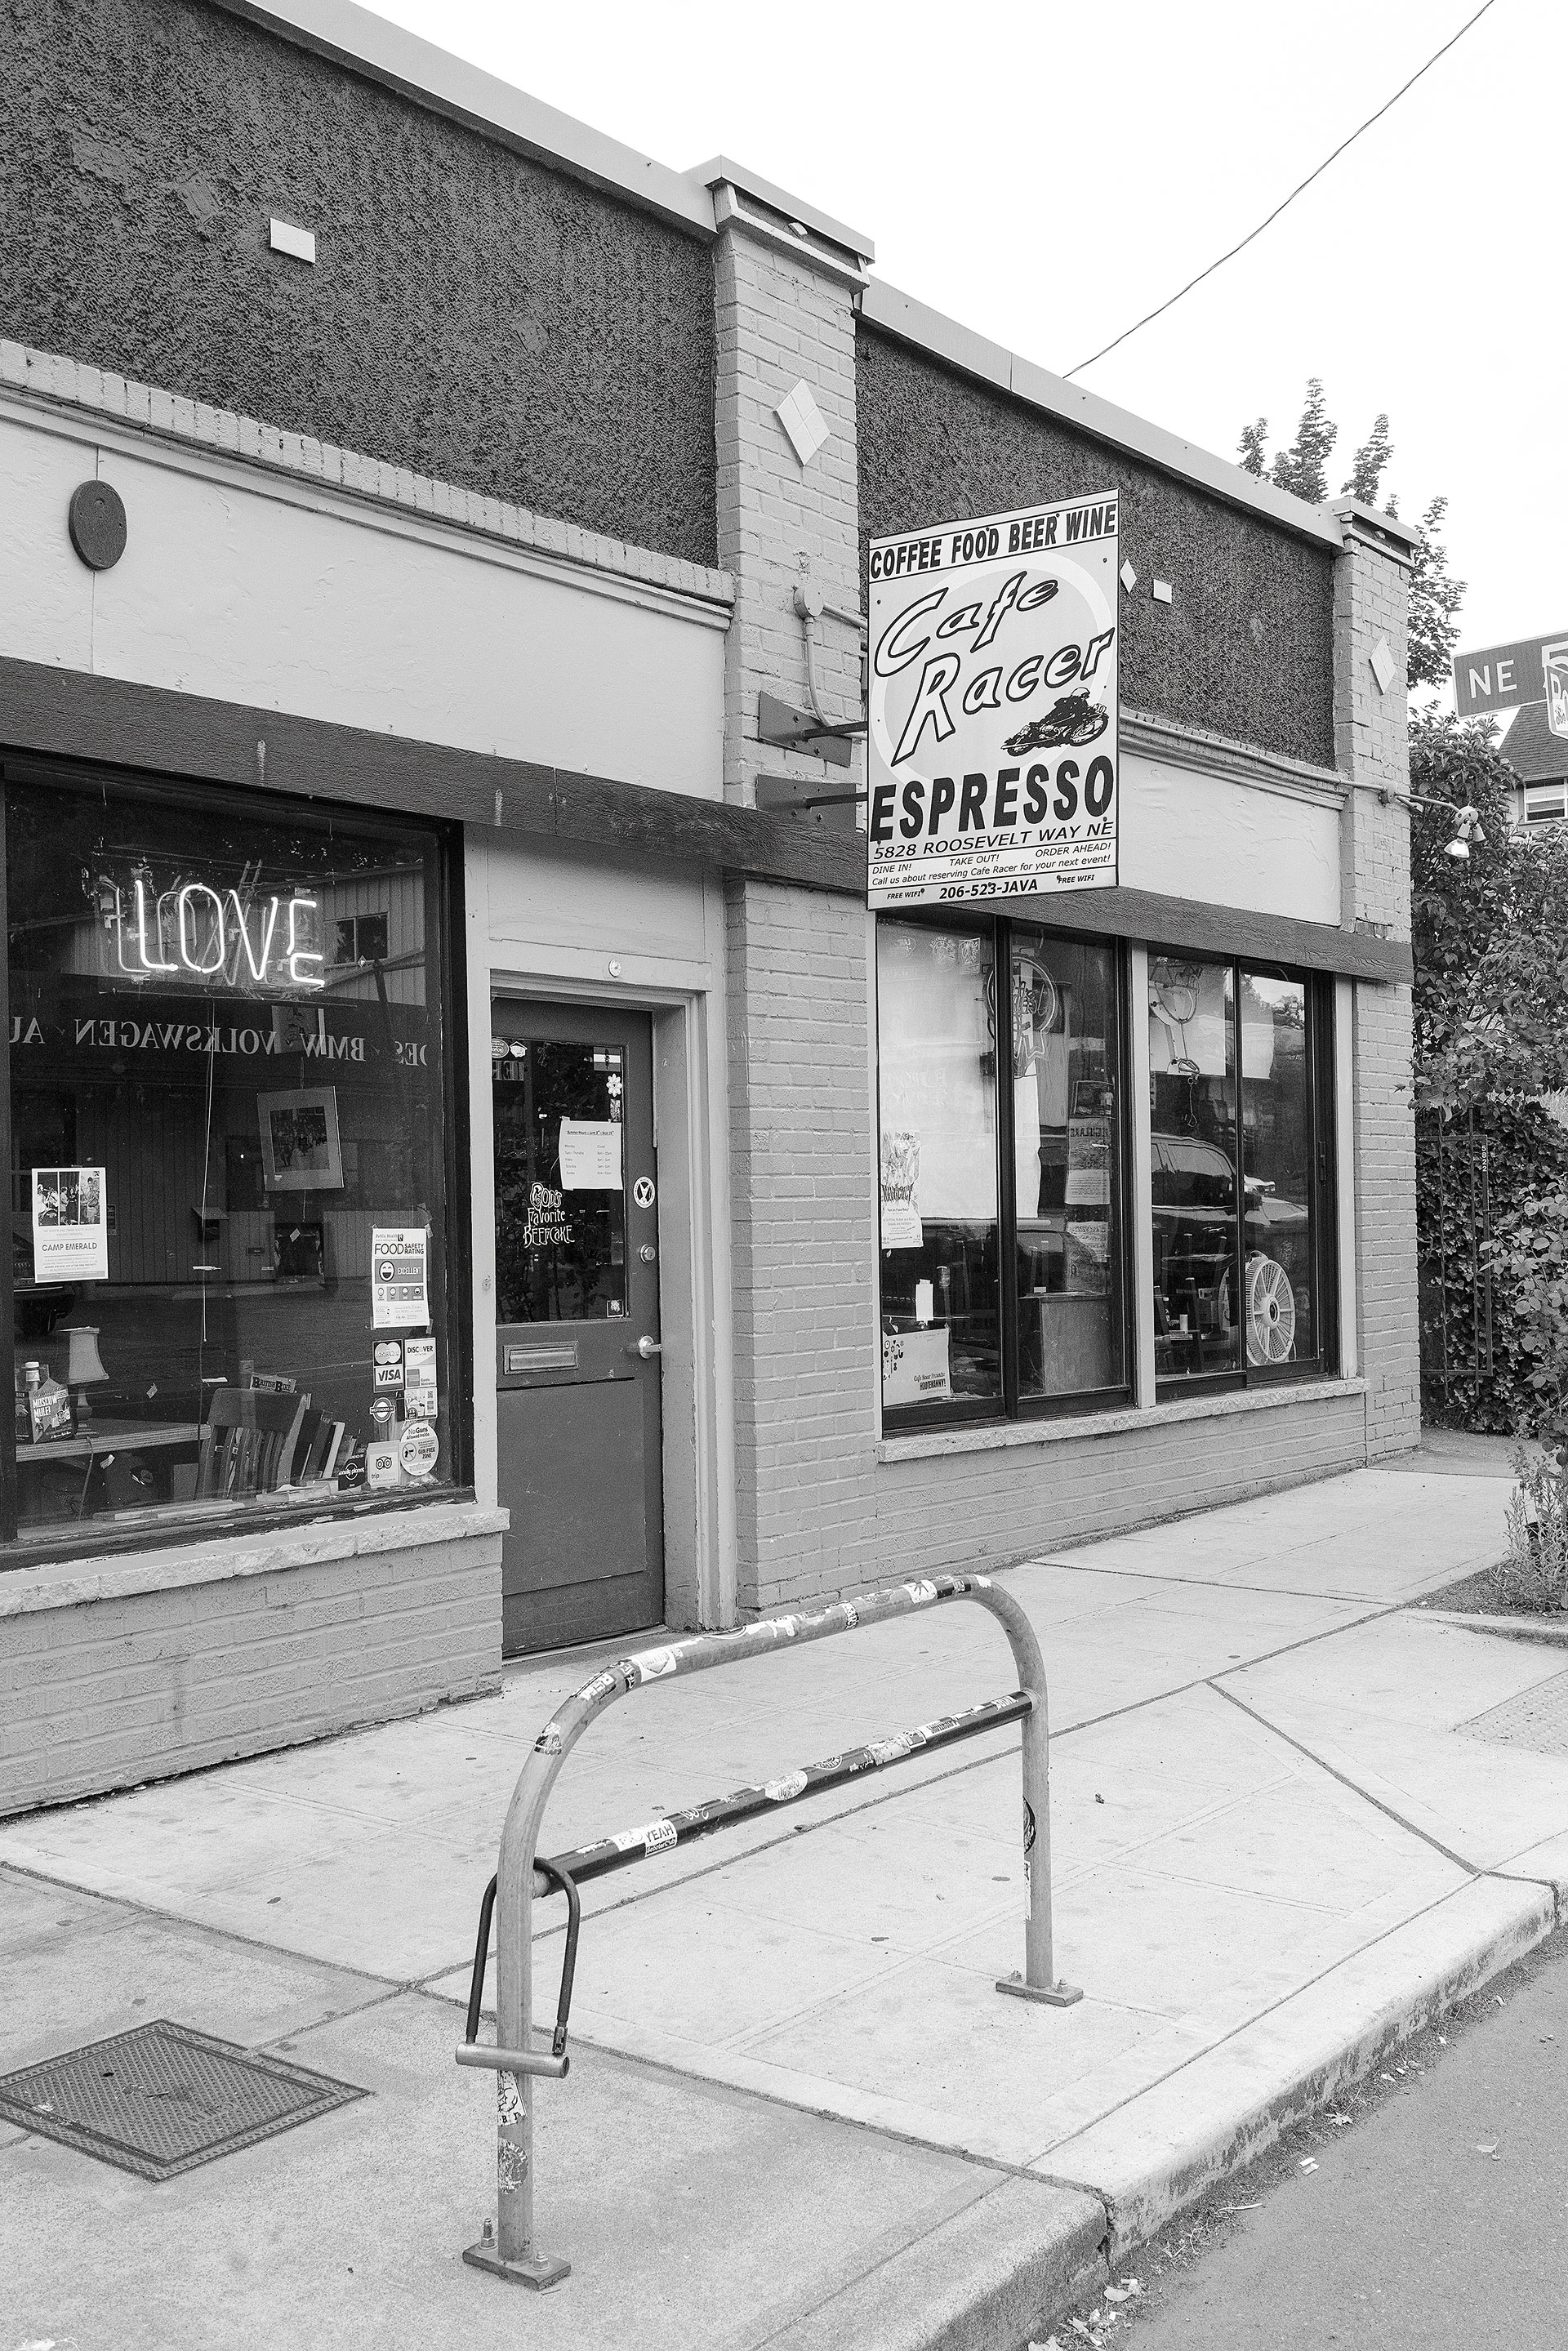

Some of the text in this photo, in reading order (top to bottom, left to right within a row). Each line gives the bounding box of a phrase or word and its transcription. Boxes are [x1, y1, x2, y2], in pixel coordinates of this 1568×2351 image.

[871, 504, 1116, 579] COFFEE FOOD BEER WINE
[874, 571, 1058, 678] Cafe
[1468, 659, 1517, 699] NE
[891, 627, 1116, 767] Racer
[870, 755, 1114, 843] ESPRESSO
[873, 821, 1115, 860] 5828 ROOSEVELT WAY NE
[1035, 843, 1111, 858] ORDER AHEAD!
[950, 854, 1000, 866] TAKE OUT!
[872, 863, 912, 875] DINE IN!
[872, 877, 888, 886] Call
[902, 874, 926, 883] about
[929, 870, 969, 882] reserving
[970, 866, 991, 877] Cafe
[992, 864, 1018, 875] Racer
[1020, 862, 1033, 871] for
[1035, 862, 1057, 871] your
[1058, 858, 1080, 867] next
[1081, 855, 1111, 865] event!
[1058, 875, 1095, 884] FREE WIFI
[939, 879, 1038, 900] 206-523-JAVA
[136, 879, 326, 989] LOVE
[42, 1242, 98, 1252] CAMP EMERALD
[374, 1243, 404, 1255] FOOD
[407, 1345, 434, 1354] DISCOVER
[378, 1369, 401, 1382] VISA
[33, 1395, 58, 1409] MOSCOW
[33, 1405, 51, 1418] MULE!
[646, 1823, 675, 1843] YEAH
